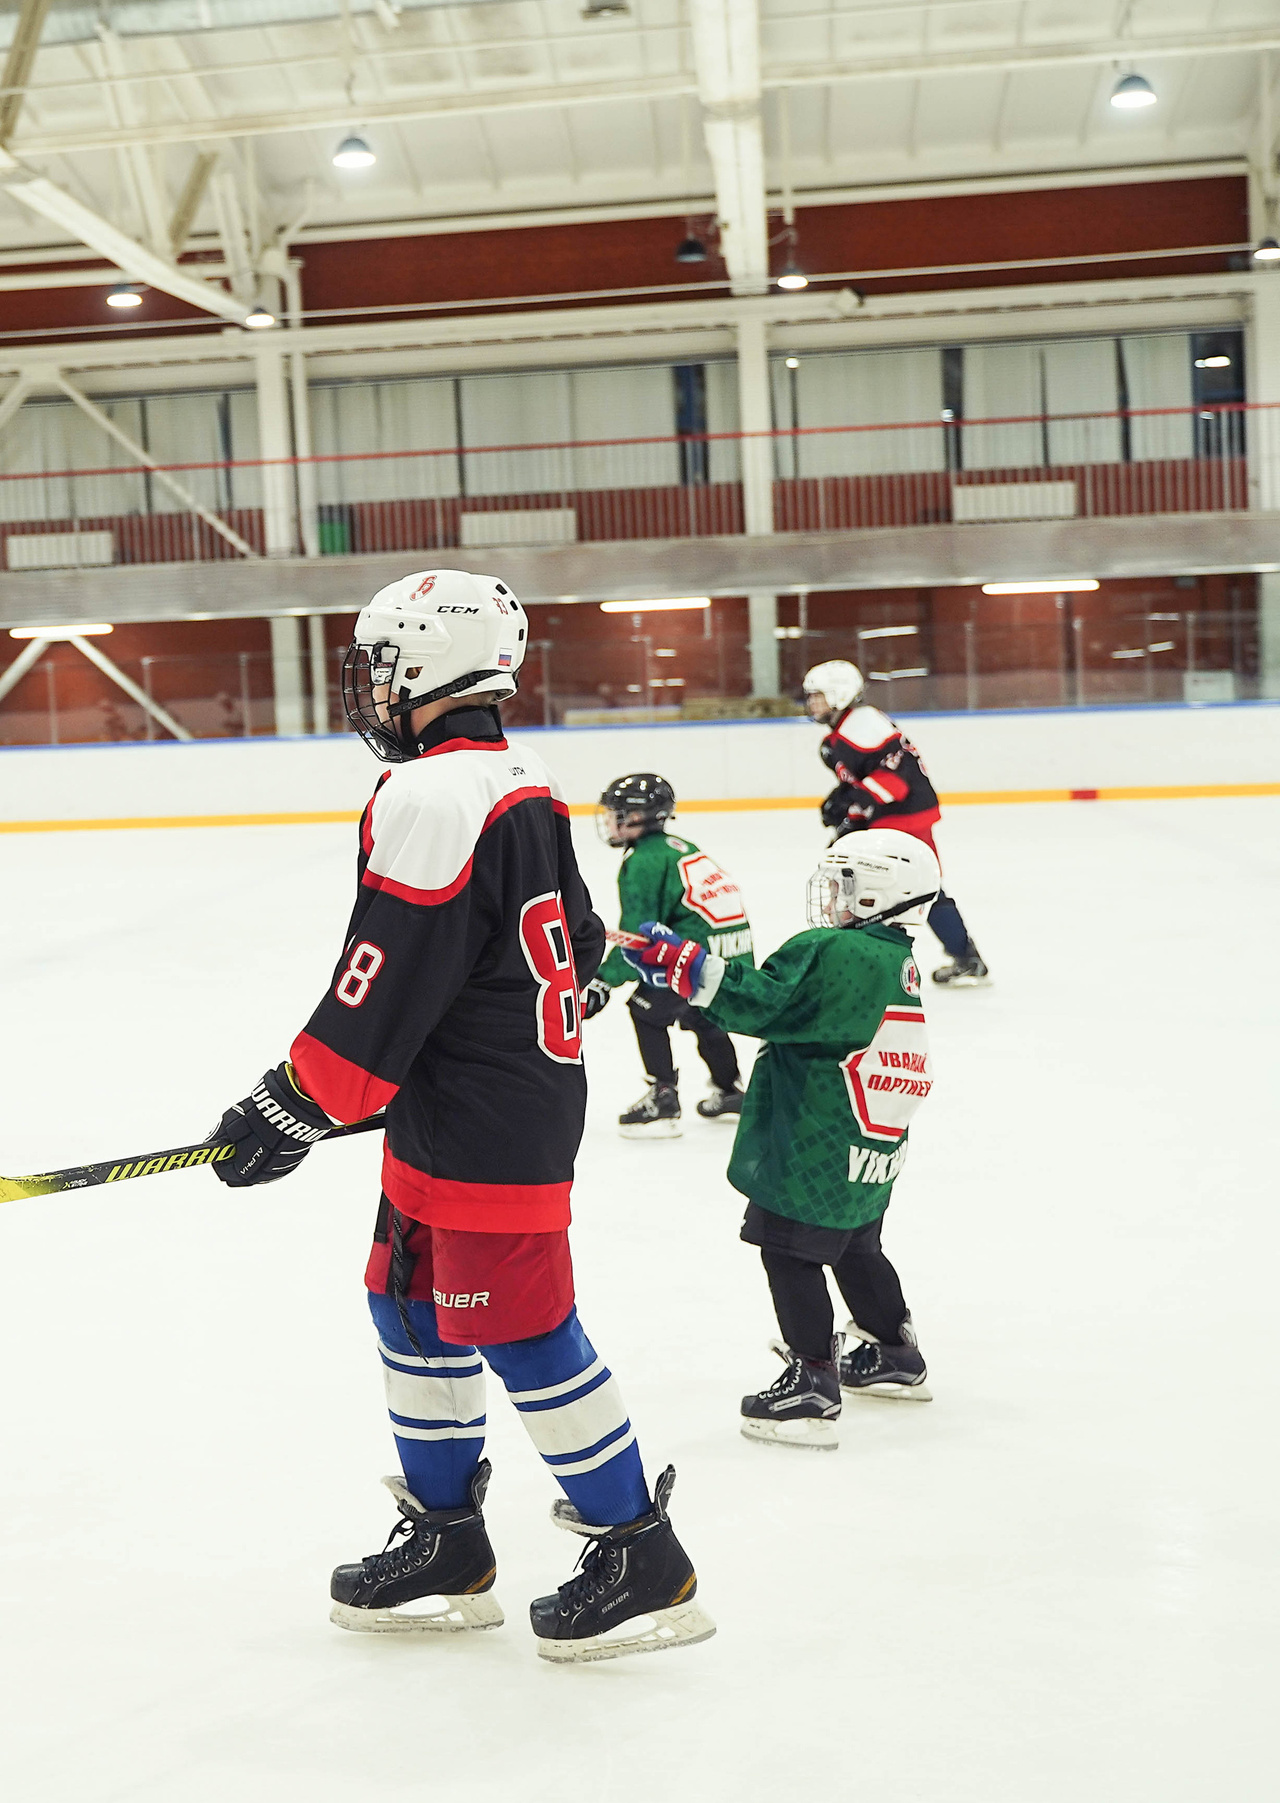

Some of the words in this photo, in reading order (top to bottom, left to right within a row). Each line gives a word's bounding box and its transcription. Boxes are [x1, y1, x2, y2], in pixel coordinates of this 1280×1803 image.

[437, 606, 479, 615] CCM
[335, 940, 385, 1008] 8
[519, 889, 583, 1065] 8
[240, 1147, 264, 1175] ALPHA
[433, 1288, 490, 1309] AUER
[601, 1591, 630, 1614] BAUER
